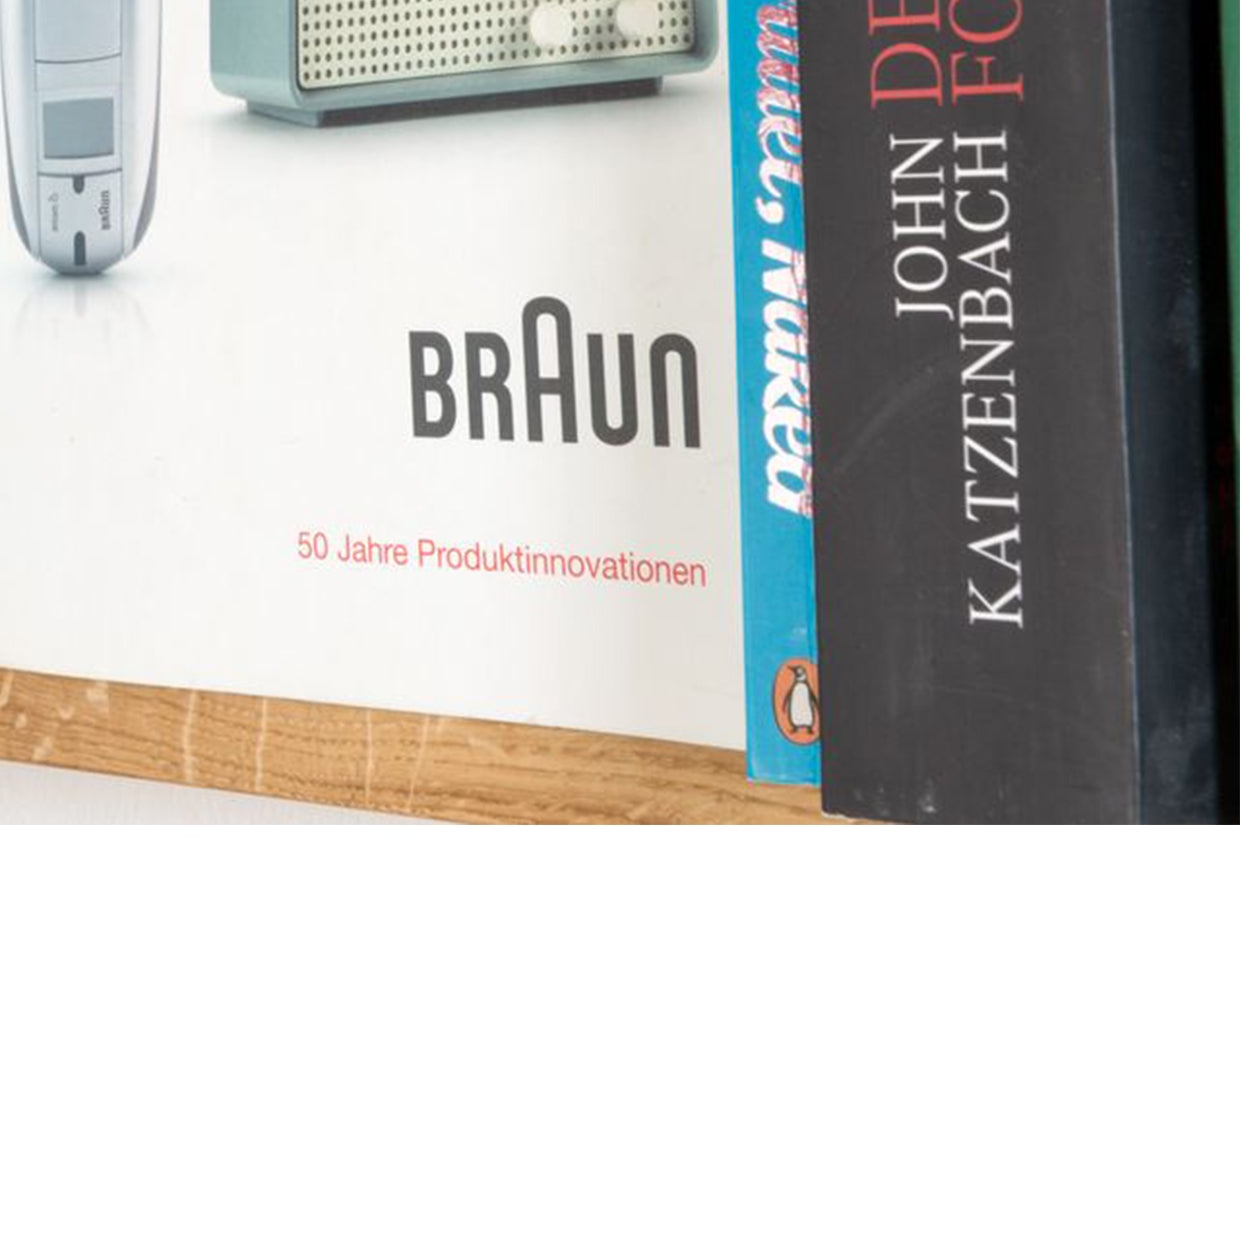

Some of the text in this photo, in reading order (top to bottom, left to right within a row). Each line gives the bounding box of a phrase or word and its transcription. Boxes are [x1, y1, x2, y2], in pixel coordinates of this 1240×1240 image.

[890, 133, 955, 319] JOHN
[408, 296, 702, 449] BRAUN
[953, 130, 1023, 628] KATZENBACH
[297, 531, 707, 587] 50 Jahre Produktinnovationen
